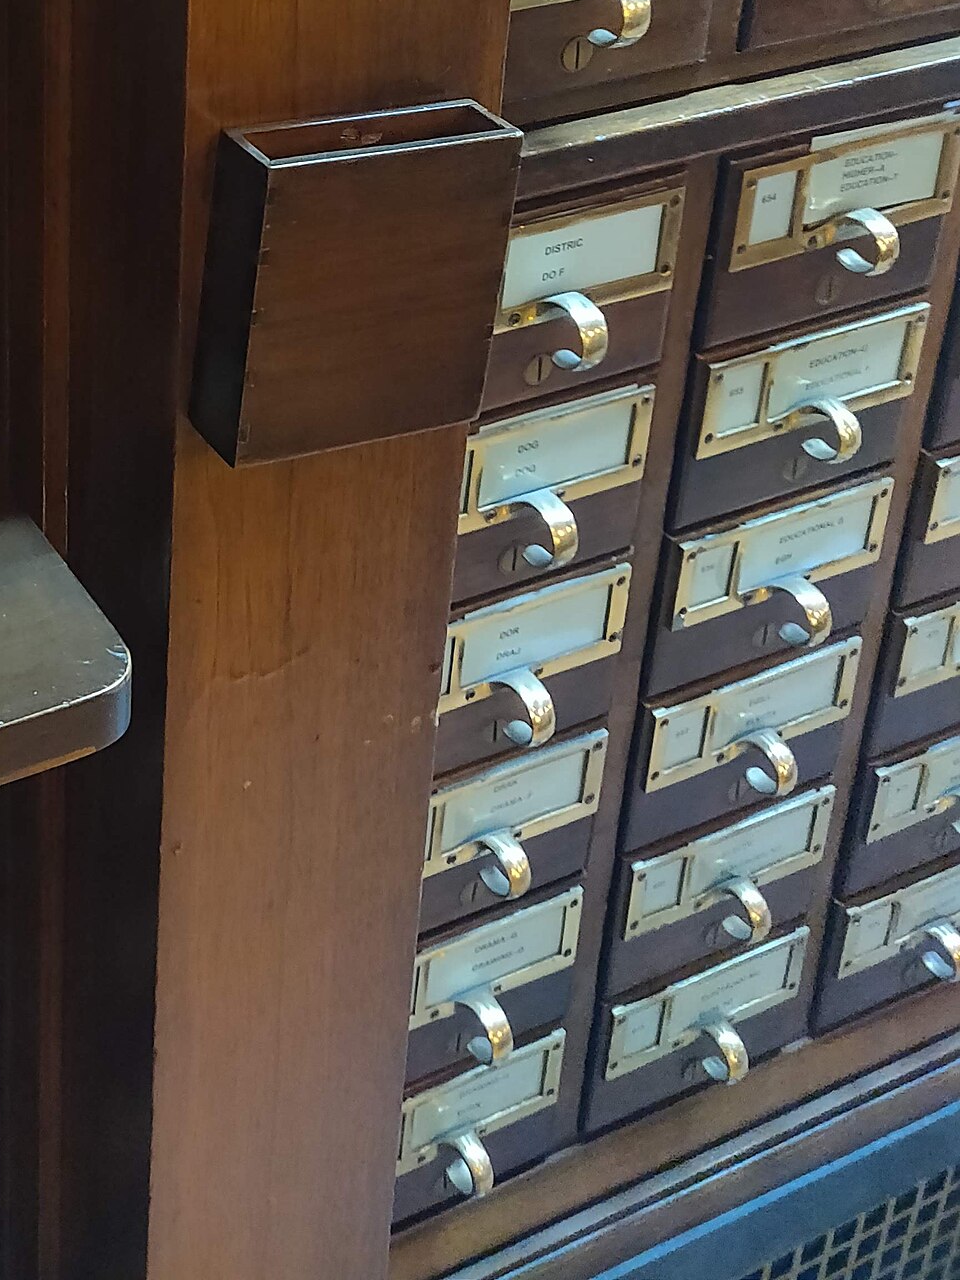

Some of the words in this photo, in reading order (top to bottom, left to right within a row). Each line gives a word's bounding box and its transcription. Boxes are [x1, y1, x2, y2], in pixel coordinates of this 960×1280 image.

[544, 238, 583, 256] DISTRIC
[542, 270, 556, 281] DO
[559, 267, 565, 277] F
